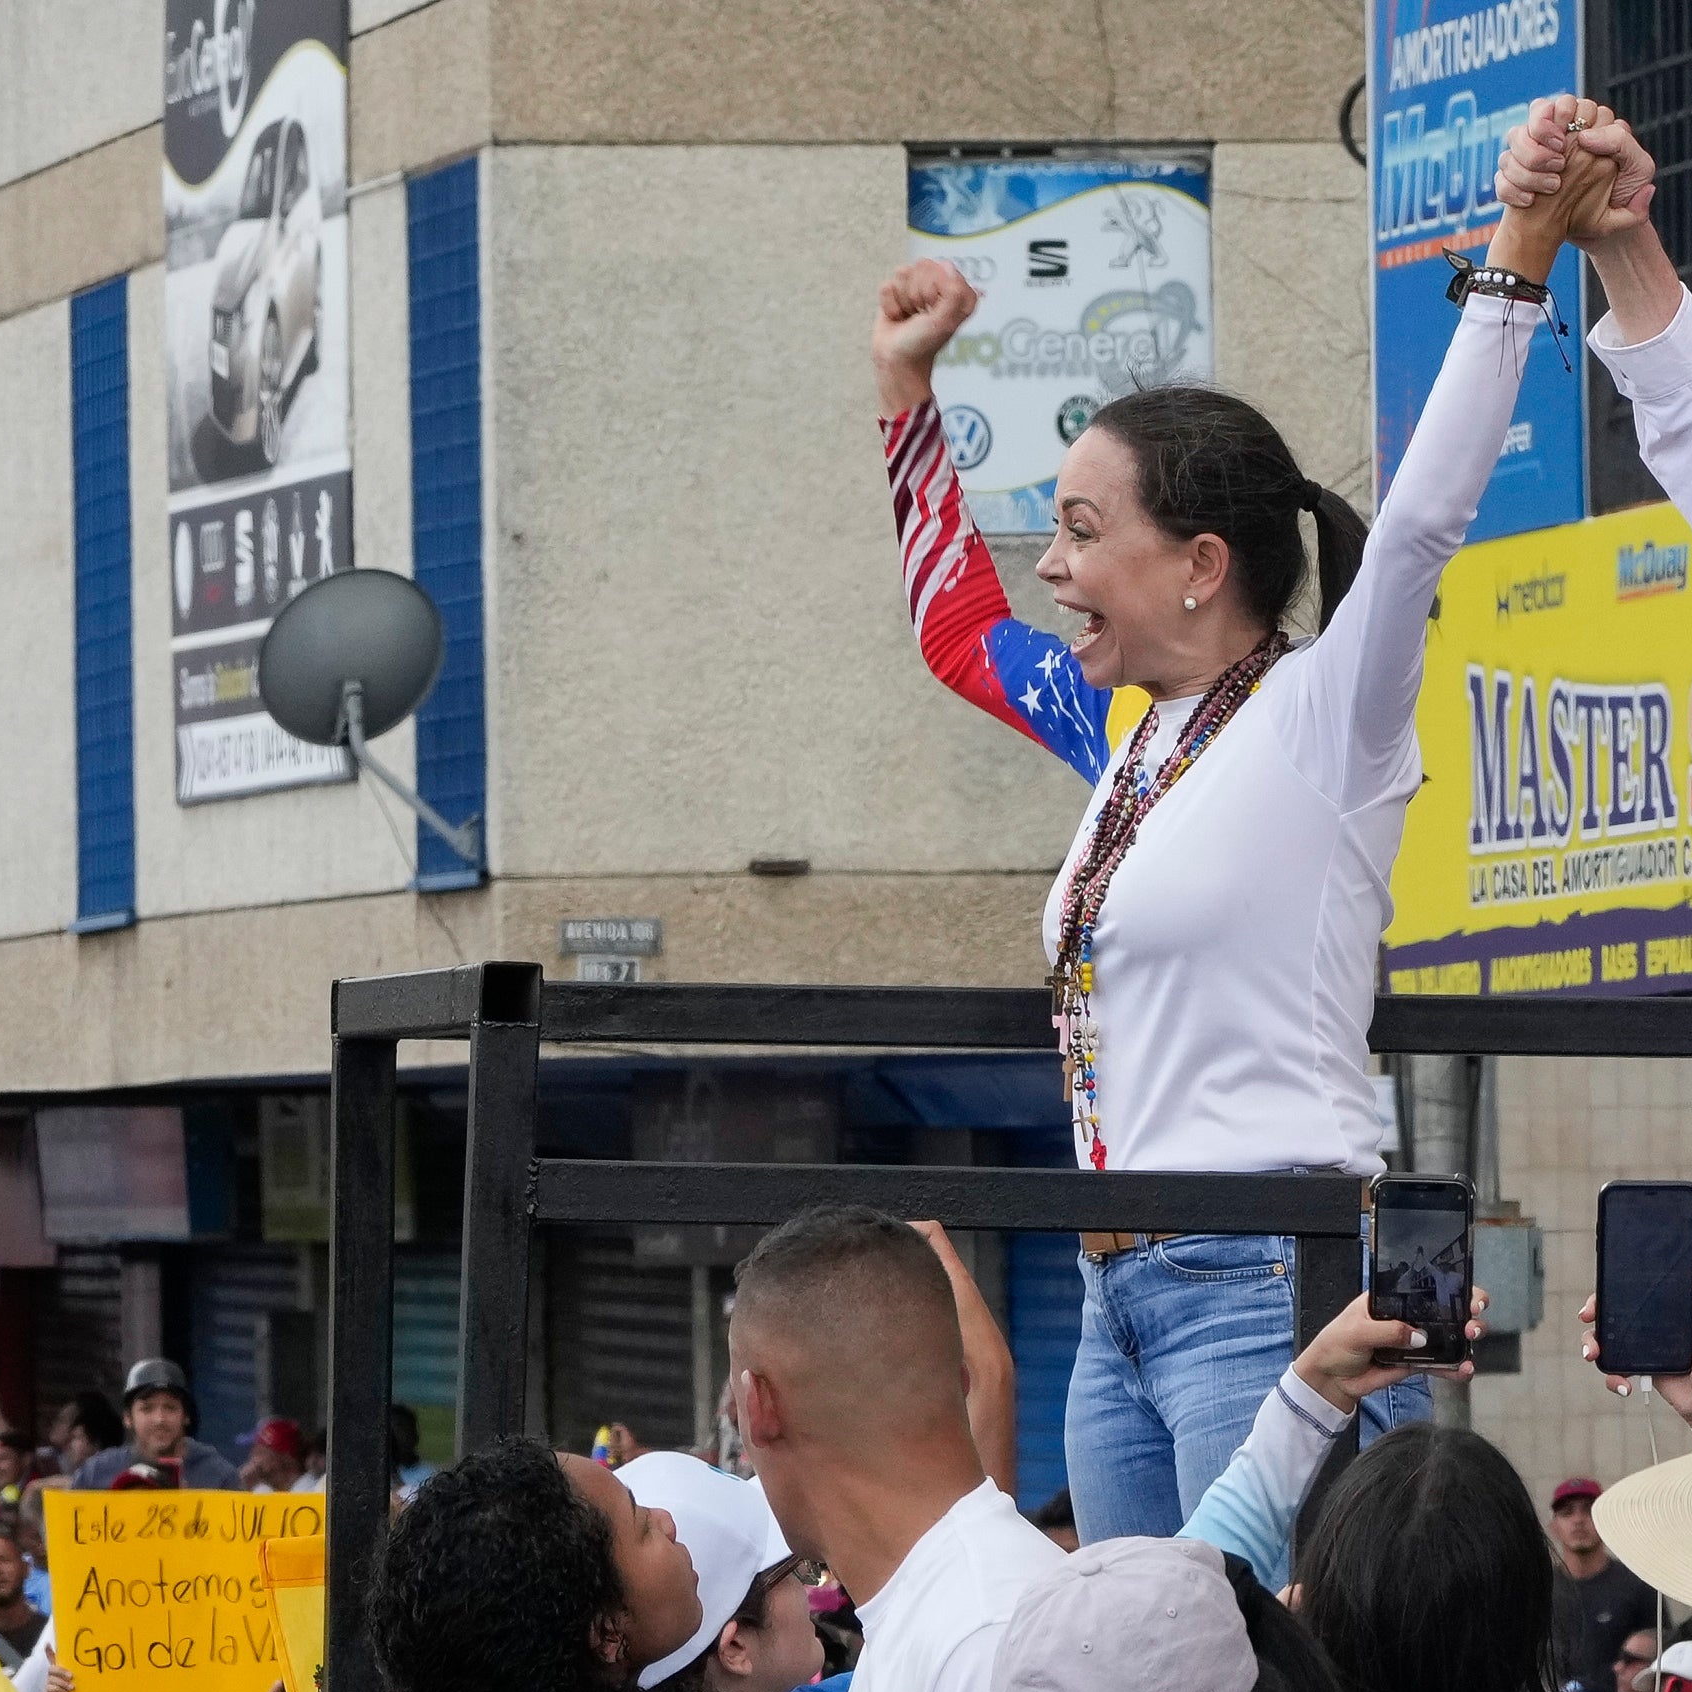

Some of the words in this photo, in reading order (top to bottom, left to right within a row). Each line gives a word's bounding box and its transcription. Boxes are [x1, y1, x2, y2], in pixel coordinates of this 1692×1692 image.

[1390, 0, 1558, 93] AMORTIGUADORES
[1616, 540, 1689, 594] McQuay
[1468, 668, 1676, 850] MASTER
[1469, 862, 1489, 904] LA
[1492, 862, 1529, 900] CASA
[1532, 857, 1558, 896] DEL
[1561, 839, 1678, 893] AMORTIGUADOR
[136, 1503, 181, 1540] 28
[74, 1627, 136, 1674] Gol
[148, 1609, 197, 1669] de
[210, 1607, 239, 1665] la
